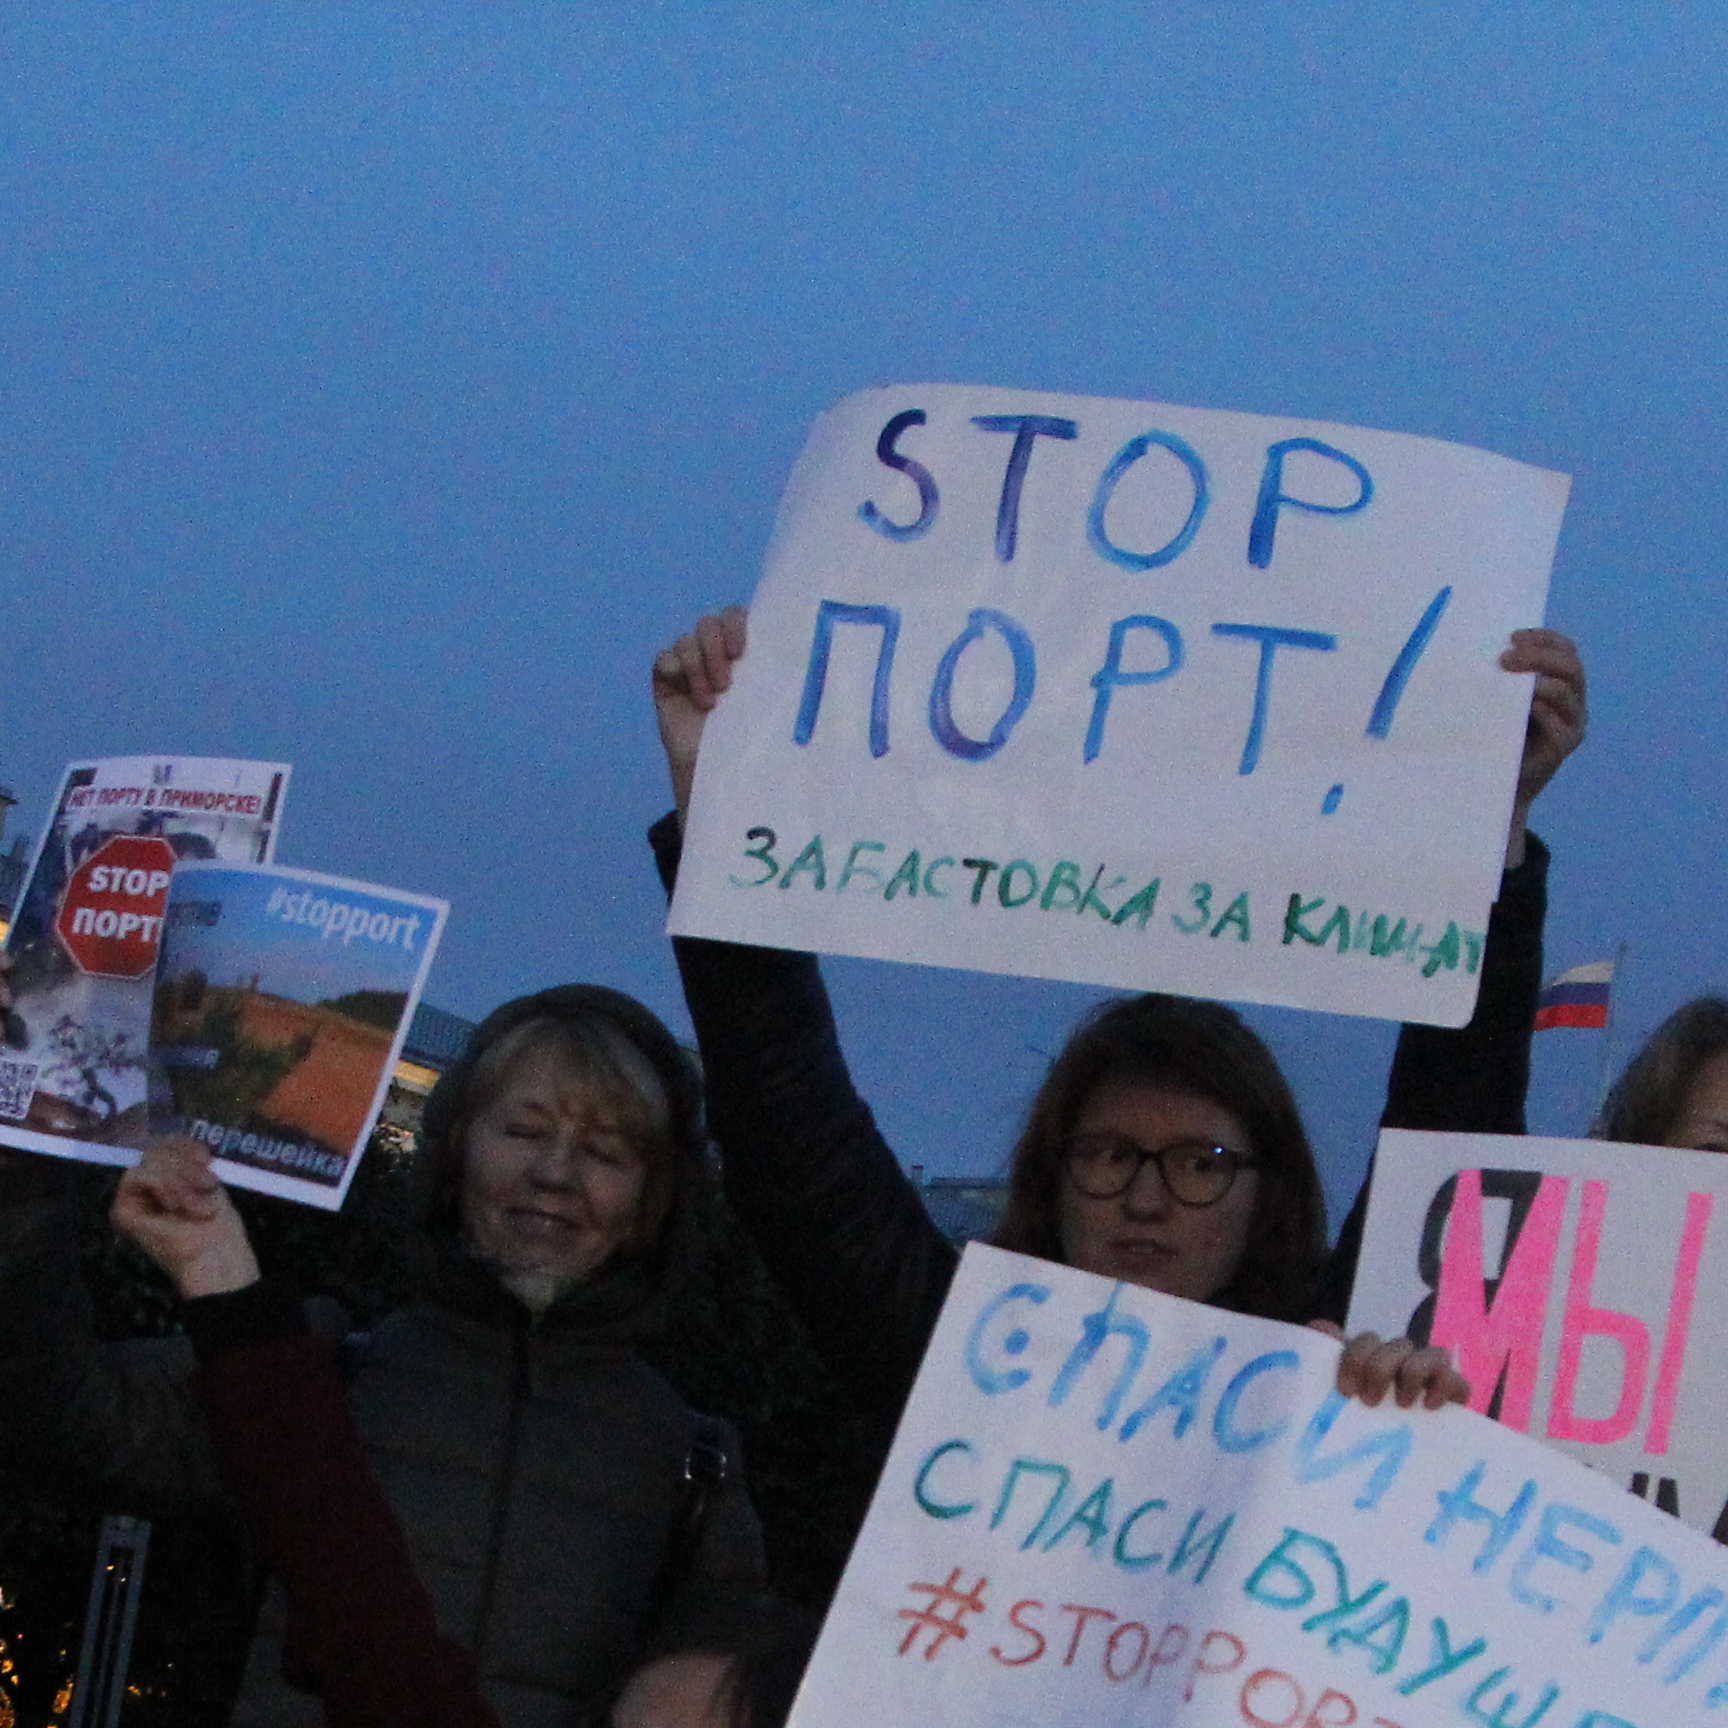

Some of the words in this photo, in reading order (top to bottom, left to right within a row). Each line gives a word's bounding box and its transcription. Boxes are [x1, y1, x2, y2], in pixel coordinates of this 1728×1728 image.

[858, 408, 1374, 570] STOP
[793, 585, 1452, 814] ПОРТ!
[87, 865, 169, 897] STOP
[266, 886, 420, 951] #stopport
[729, 825, 1161, 926] ЗАБАСТОВКА
[1171, 882, 1253, 943] ЗА
[1427, 1169, 1714, 1455] МЫ
[964, 1281, 1412, 1512] СПАСИ
[912, 1441, 1236, 1587] СПАСИ
